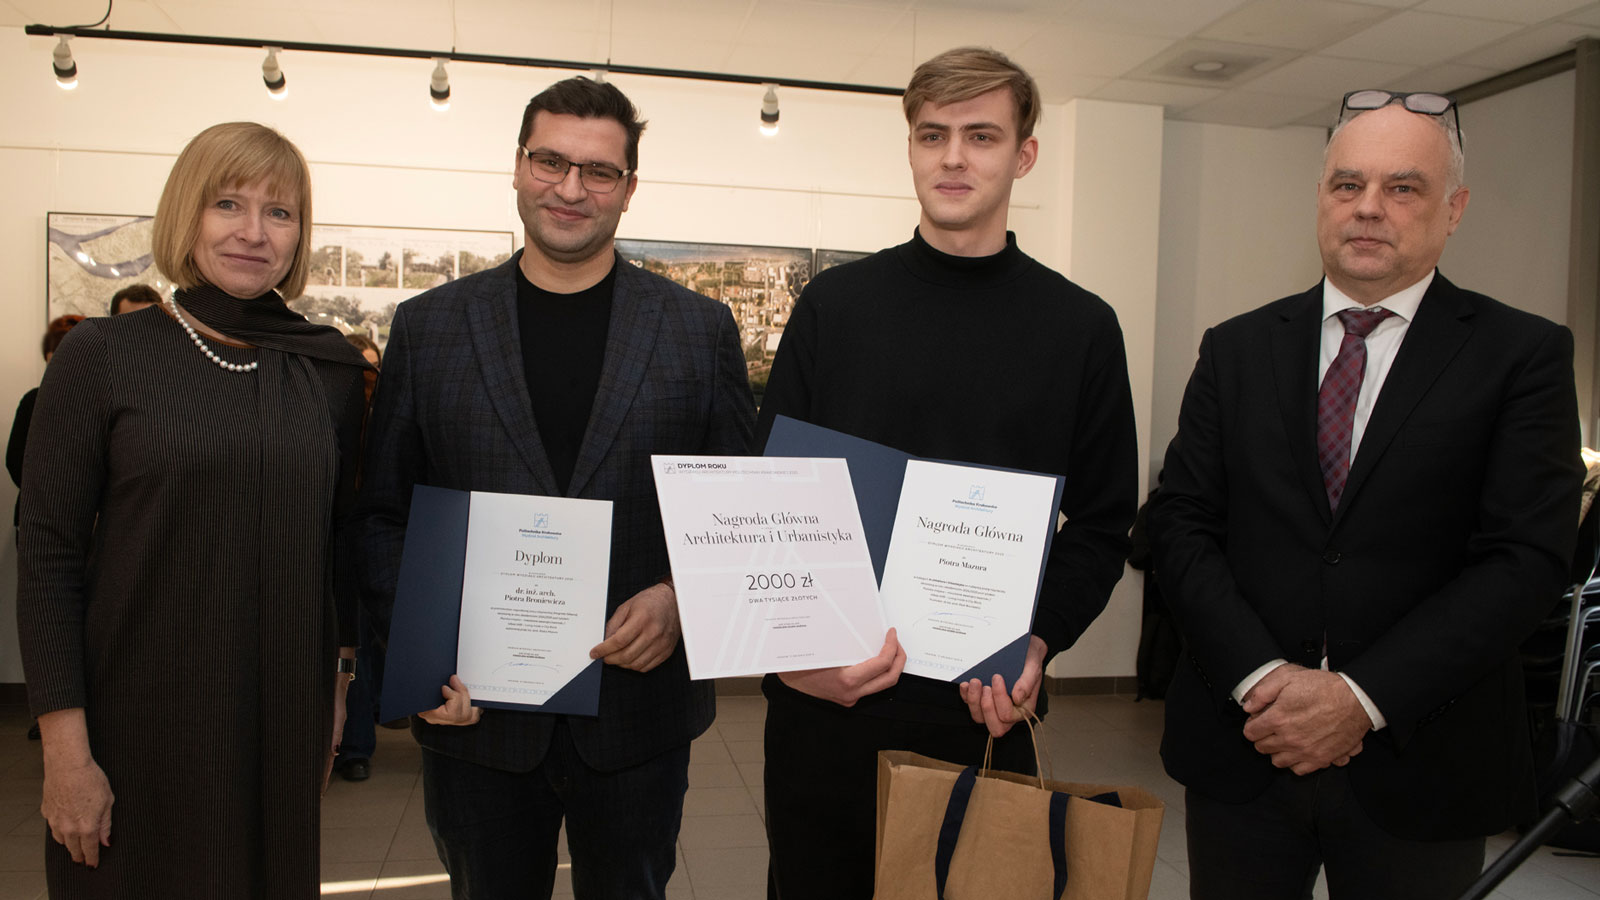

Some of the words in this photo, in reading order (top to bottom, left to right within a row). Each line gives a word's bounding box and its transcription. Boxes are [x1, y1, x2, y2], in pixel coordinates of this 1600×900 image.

[712, 512, 768, 529] Nagroda
[771, 511, 819, 526] Główna
[683, 531, 766, 546] Architektura
[769, 530, 774, 543] i
[777, 528, 852, 545] Urbanistyka
[916, 516, 970, 535] Nagroda
[974, 524, 1024, 543] Główna
[515, 550, 563, 566] Dyplom
[938, 557, 960, 567] Piotra
[961, 561, 987, 572] Mazura
[745, 572, 796, 591] 2000
[800, 572, 814, 588] zł
[504, 594, 525, 603] Piotra
[525, 595, 566, 606] Broniewicza
[515, 587, 525, 595] dr.
[526, 587, 538, 596] inż.
[539, 589, 556, 597] arch.
[765, 596, 790, 604] TYSIĄCE
